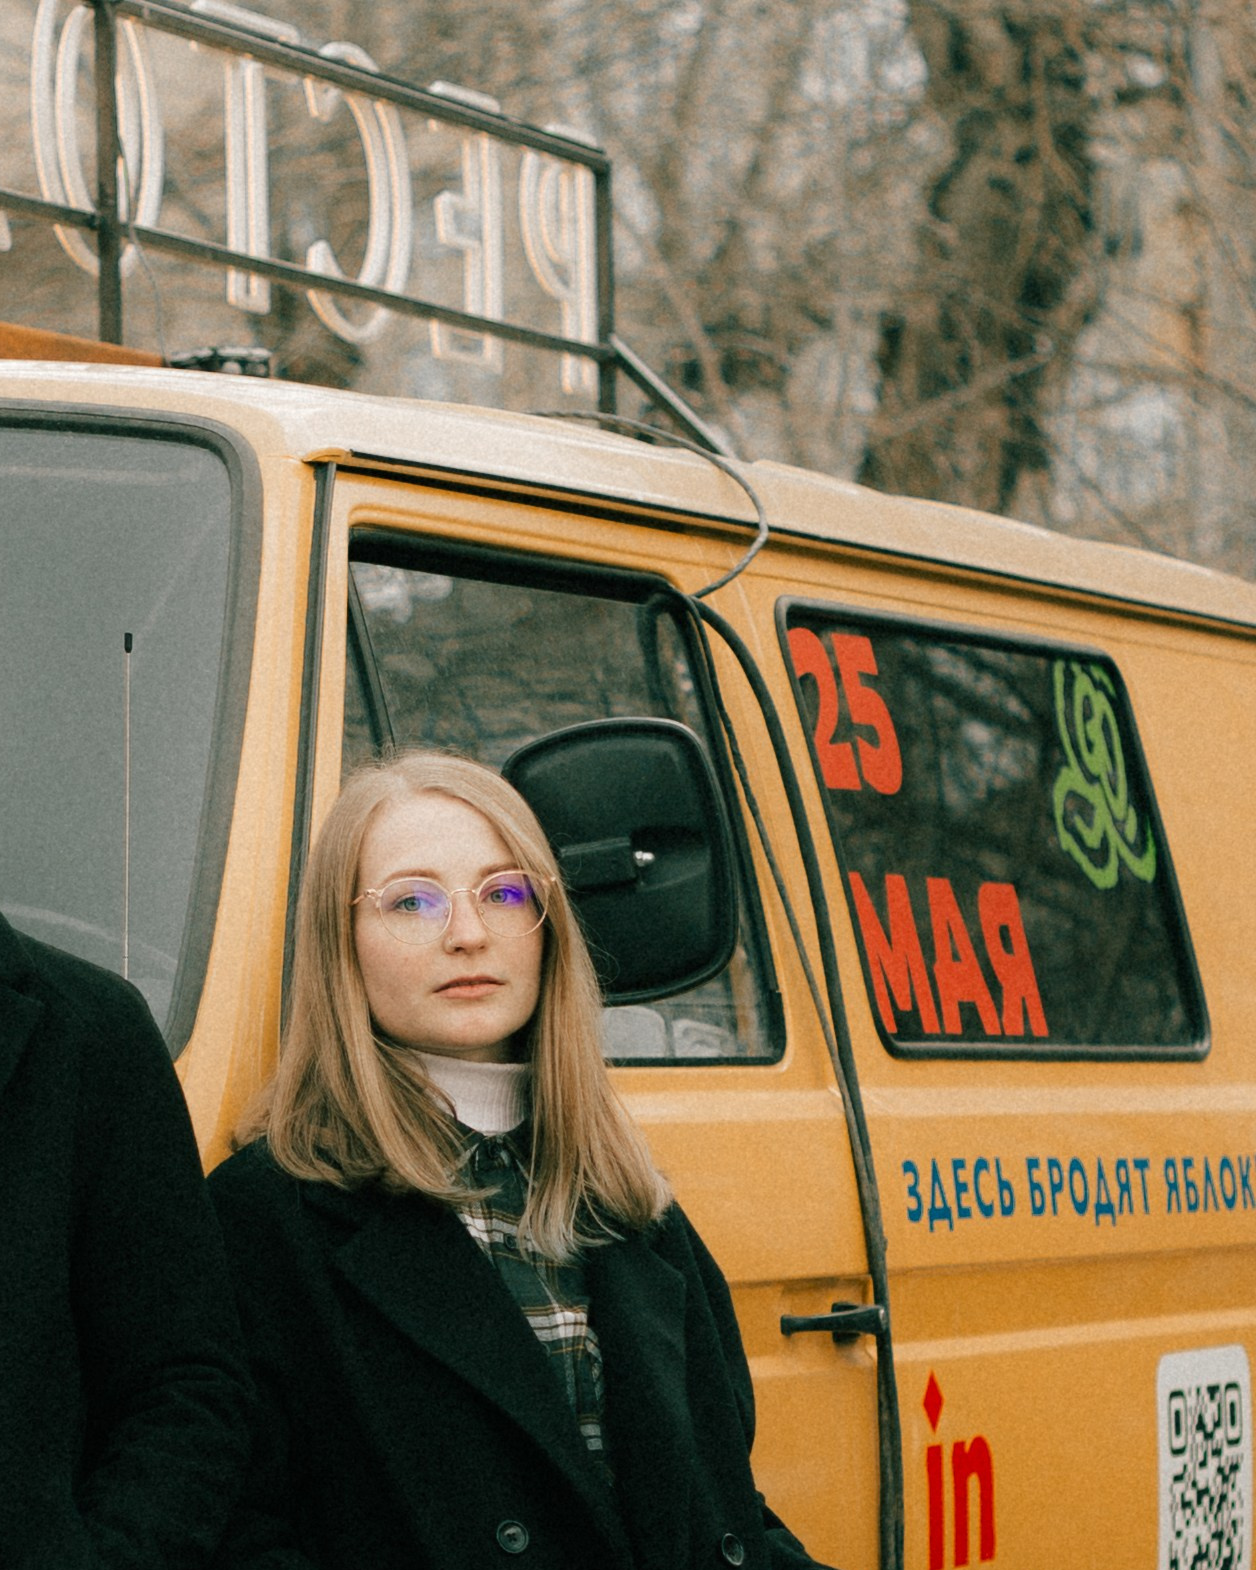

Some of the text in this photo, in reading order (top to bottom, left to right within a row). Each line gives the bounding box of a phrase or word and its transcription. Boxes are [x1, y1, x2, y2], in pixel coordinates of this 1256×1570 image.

[786, 627, 903, 796] 25
[849, 871, 1049, 1037] МАЯ
[902, 1155, 1256, 1232] ЗДЕСЬ БРОДЯТ ЯБЛОК
